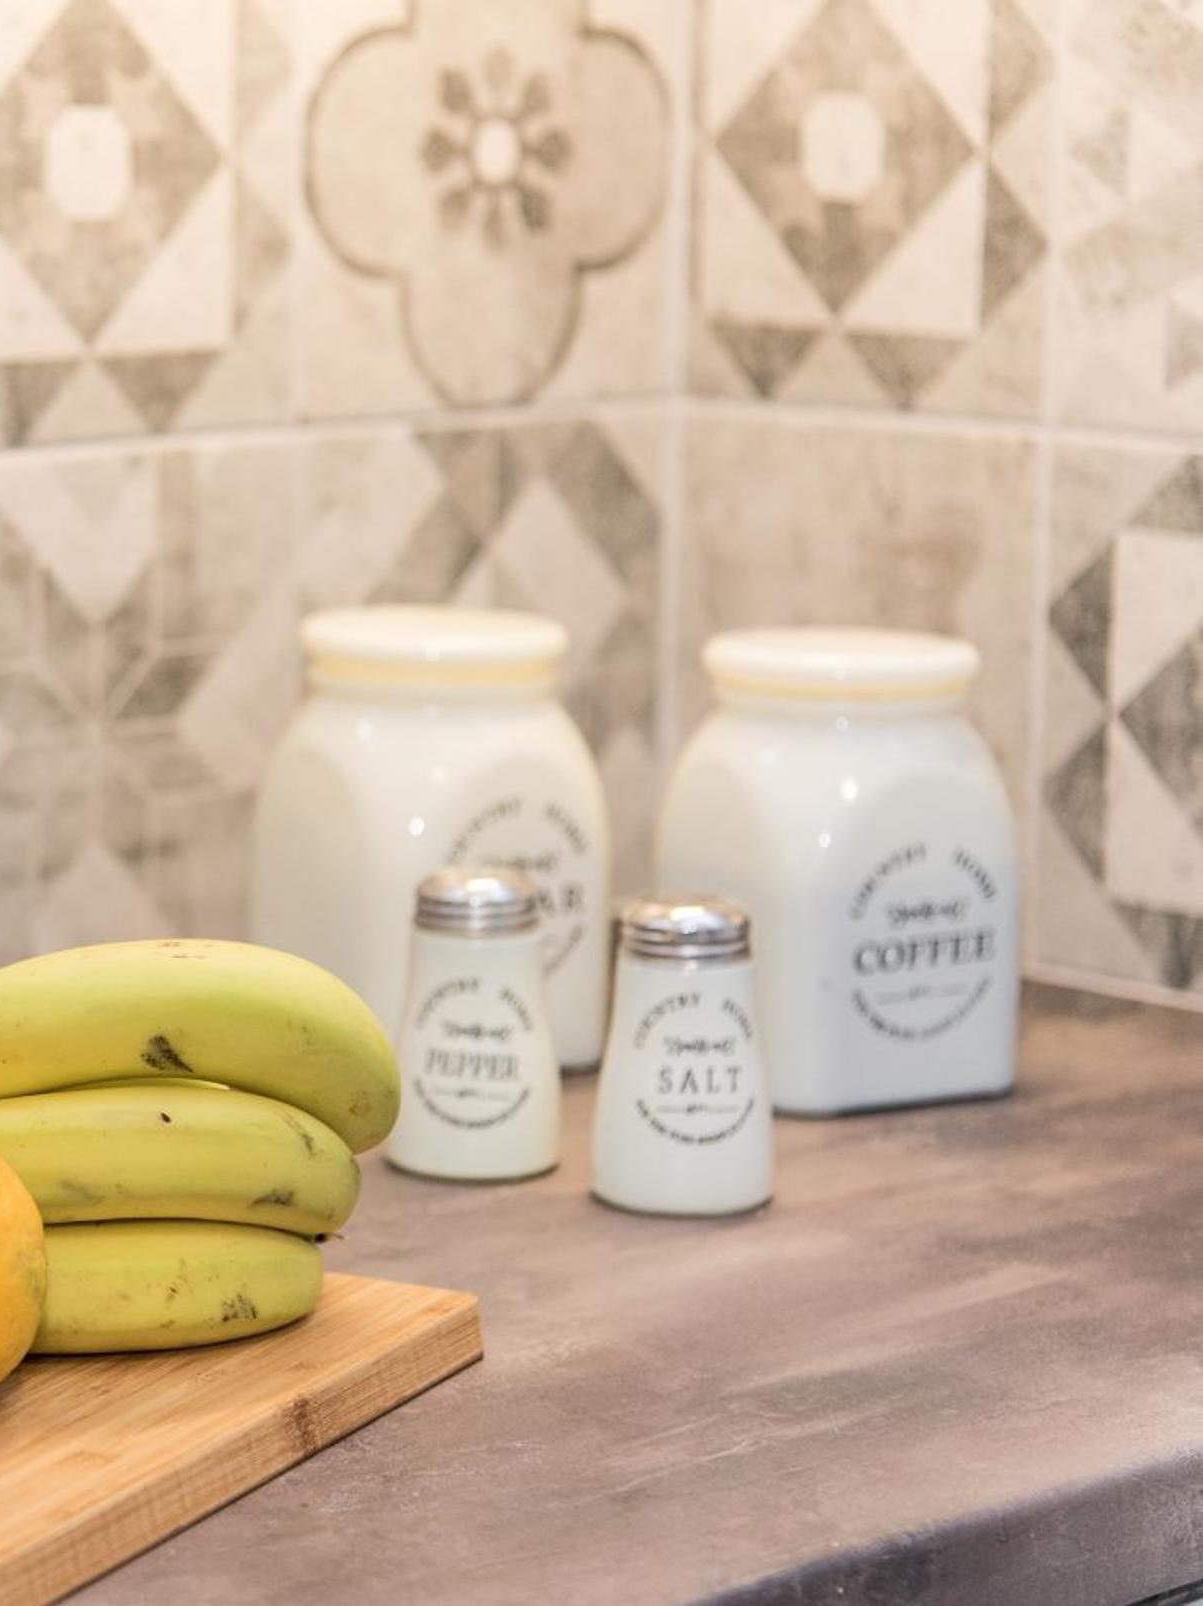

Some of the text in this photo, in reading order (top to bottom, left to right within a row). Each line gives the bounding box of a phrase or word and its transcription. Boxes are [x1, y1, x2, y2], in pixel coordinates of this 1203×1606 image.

[852, 925, 998, 977] COFFEE
[423, 1047, 520, 1081] PEPPER
[657, 1065, 743, 1095] SALT
